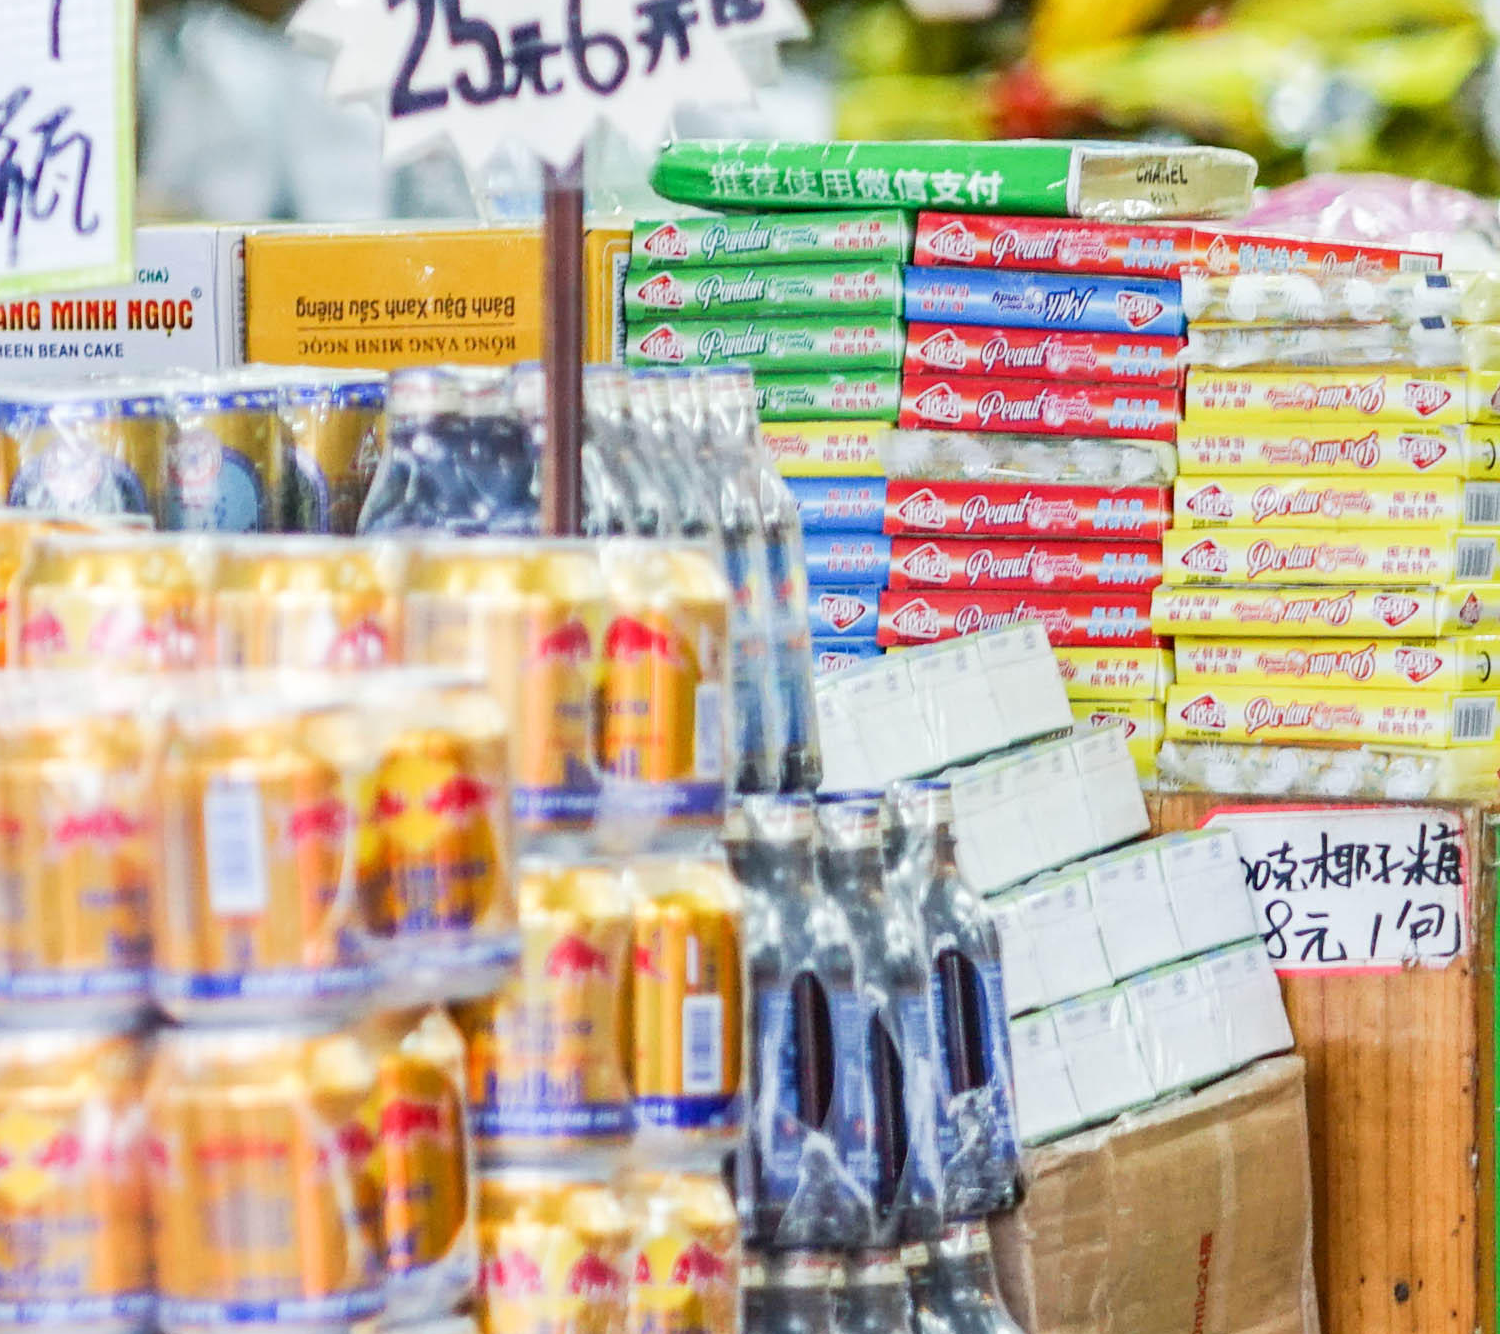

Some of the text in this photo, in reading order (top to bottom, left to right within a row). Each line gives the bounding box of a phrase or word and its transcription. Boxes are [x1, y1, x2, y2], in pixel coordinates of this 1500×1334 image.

[709, 161, 1004, 207] 推荐使用微信支付
[295, 295, 344, 324] Riêng
[384, 295, 429, 323] Xanh
[433, 293, 468, 323] Đậu
[471, 295, 516, 323] Bánh
[1045, 286, 1097, 322] Milk
[51, 299, 193, 339] MINH NGỌC
[38, 343, 81, 360] BEAN
[84, 342, 124, 359] CAKE
[298, 337, 349, 357] NGỌC
[355, 338, 404, 355] MINH
[960, 491, 1031, 532] Peanut
[965, 546, 1035, 585] Peanut
